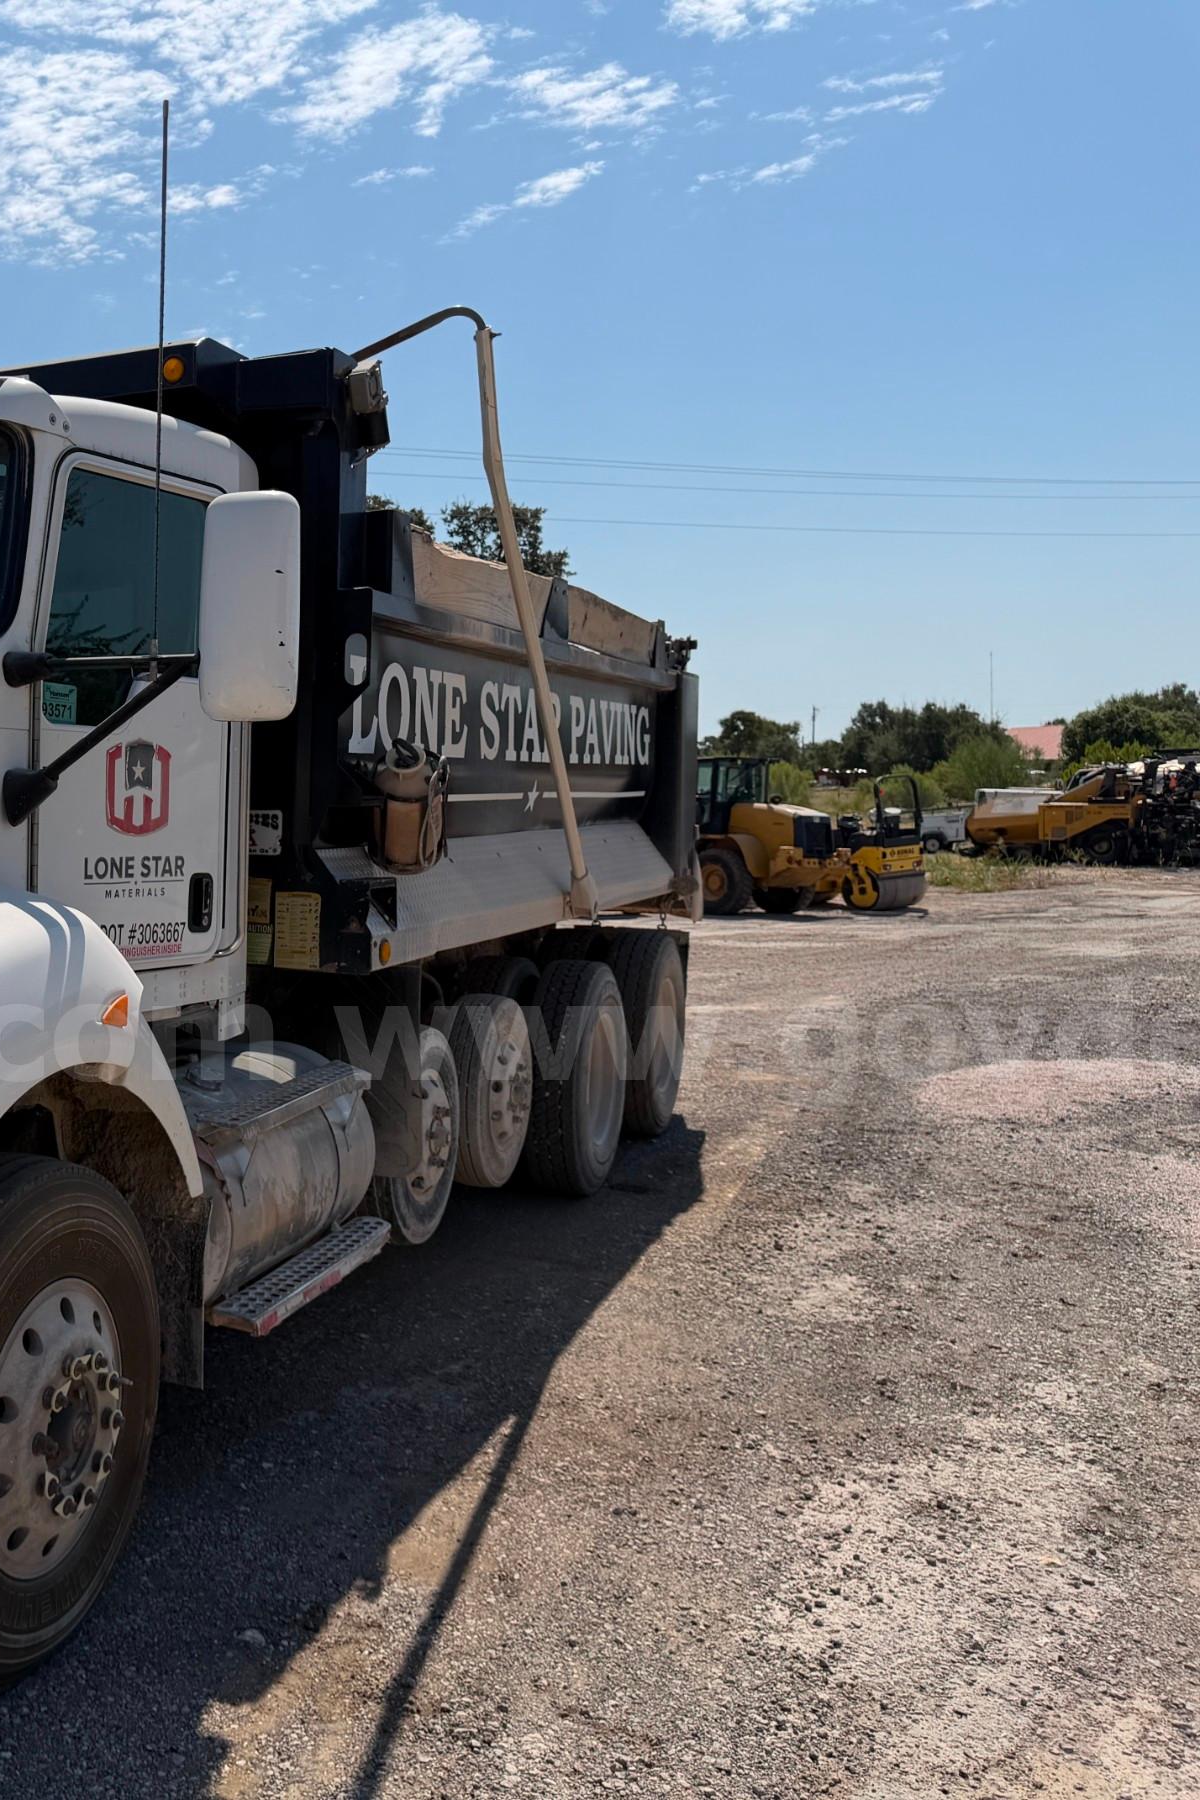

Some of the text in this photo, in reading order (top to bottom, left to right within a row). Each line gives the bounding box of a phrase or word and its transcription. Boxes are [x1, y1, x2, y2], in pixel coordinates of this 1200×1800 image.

[42, 702, 72, 719] 93571
[348, 654, 468, 759] LONE
[569, 695, 650, 765] PAVING
[83, 855, 185, 880] LONE STAR
[104, 887, 166, 899] MATERIALS
[128, 921, 186, 945] #3063667
[161, 943, 182, 954] INSIDE
